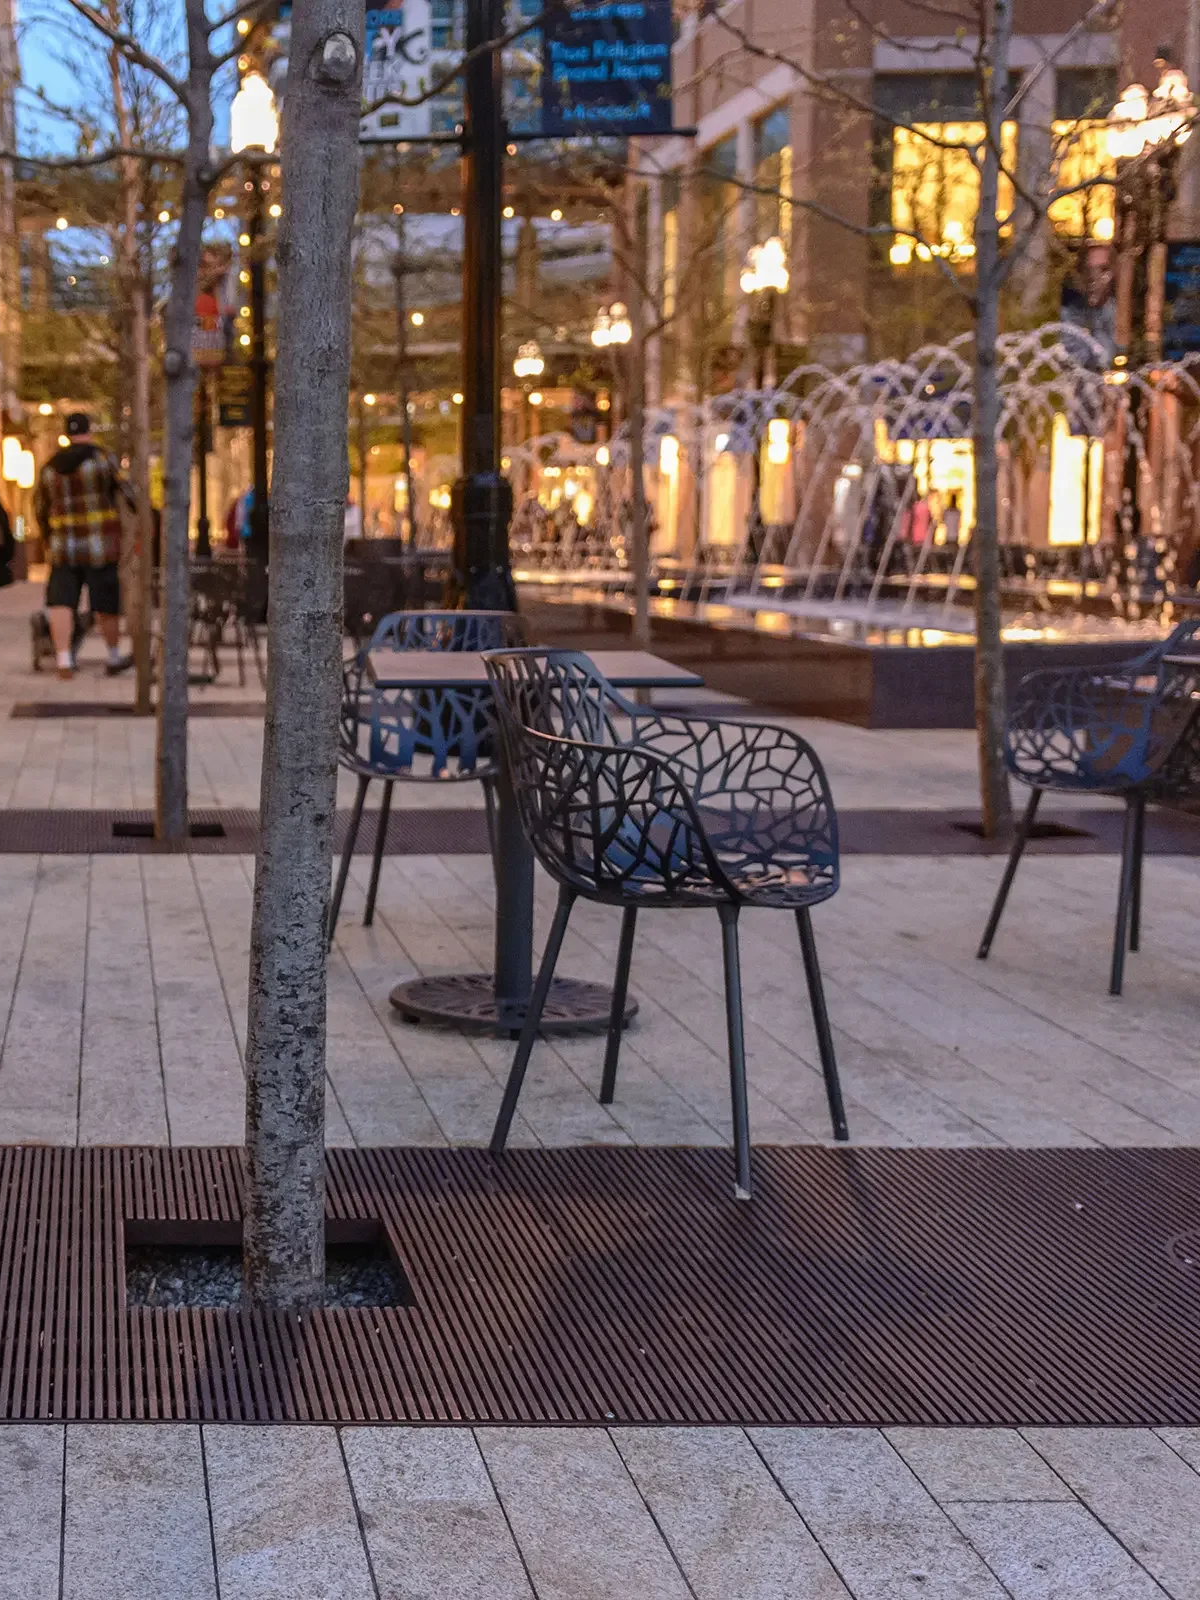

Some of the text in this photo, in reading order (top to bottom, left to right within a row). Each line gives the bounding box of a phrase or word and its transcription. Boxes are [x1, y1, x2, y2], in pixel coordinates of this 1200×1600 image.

[593, 40, 668, 60] Religion
[612, 60, 662, 79] Jeans
[563, 103, 651, 120] Microsoft
